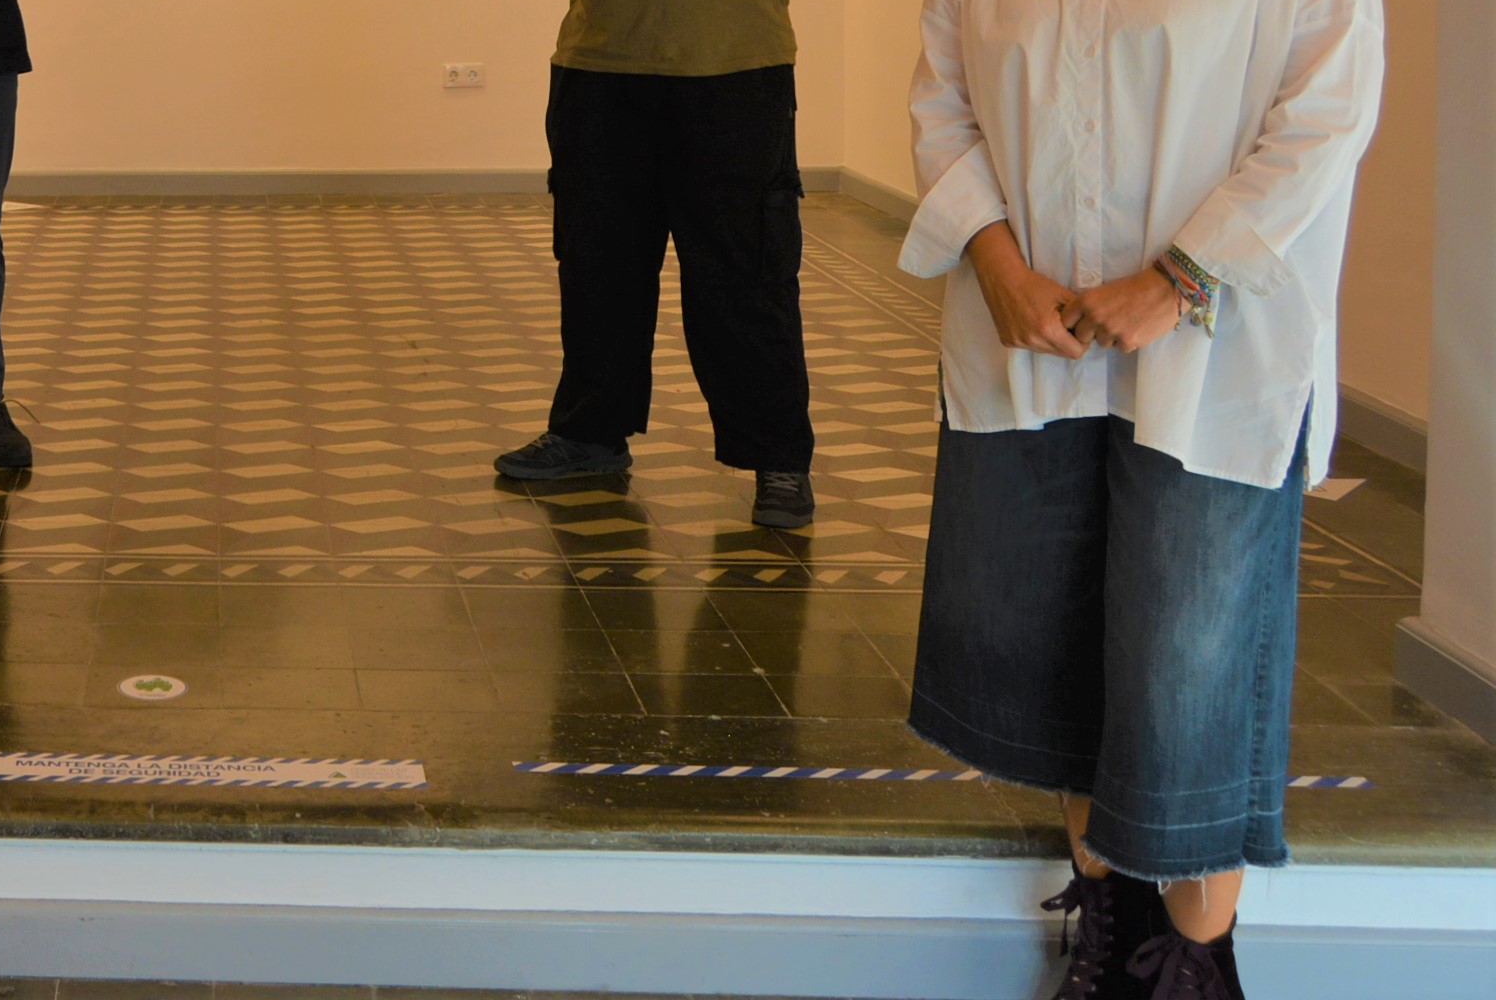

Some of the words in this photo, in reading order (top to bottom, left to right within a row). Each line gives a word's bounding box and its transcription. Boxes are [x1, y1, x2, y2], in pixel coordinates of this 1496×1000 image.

[15, 760, 130, 769] MANTENGA
[137, 762, 162, 770] LA
[168, 763, 276, 772] DISTANCIA
[102, 768, 221, 777] SEGURIDAD
